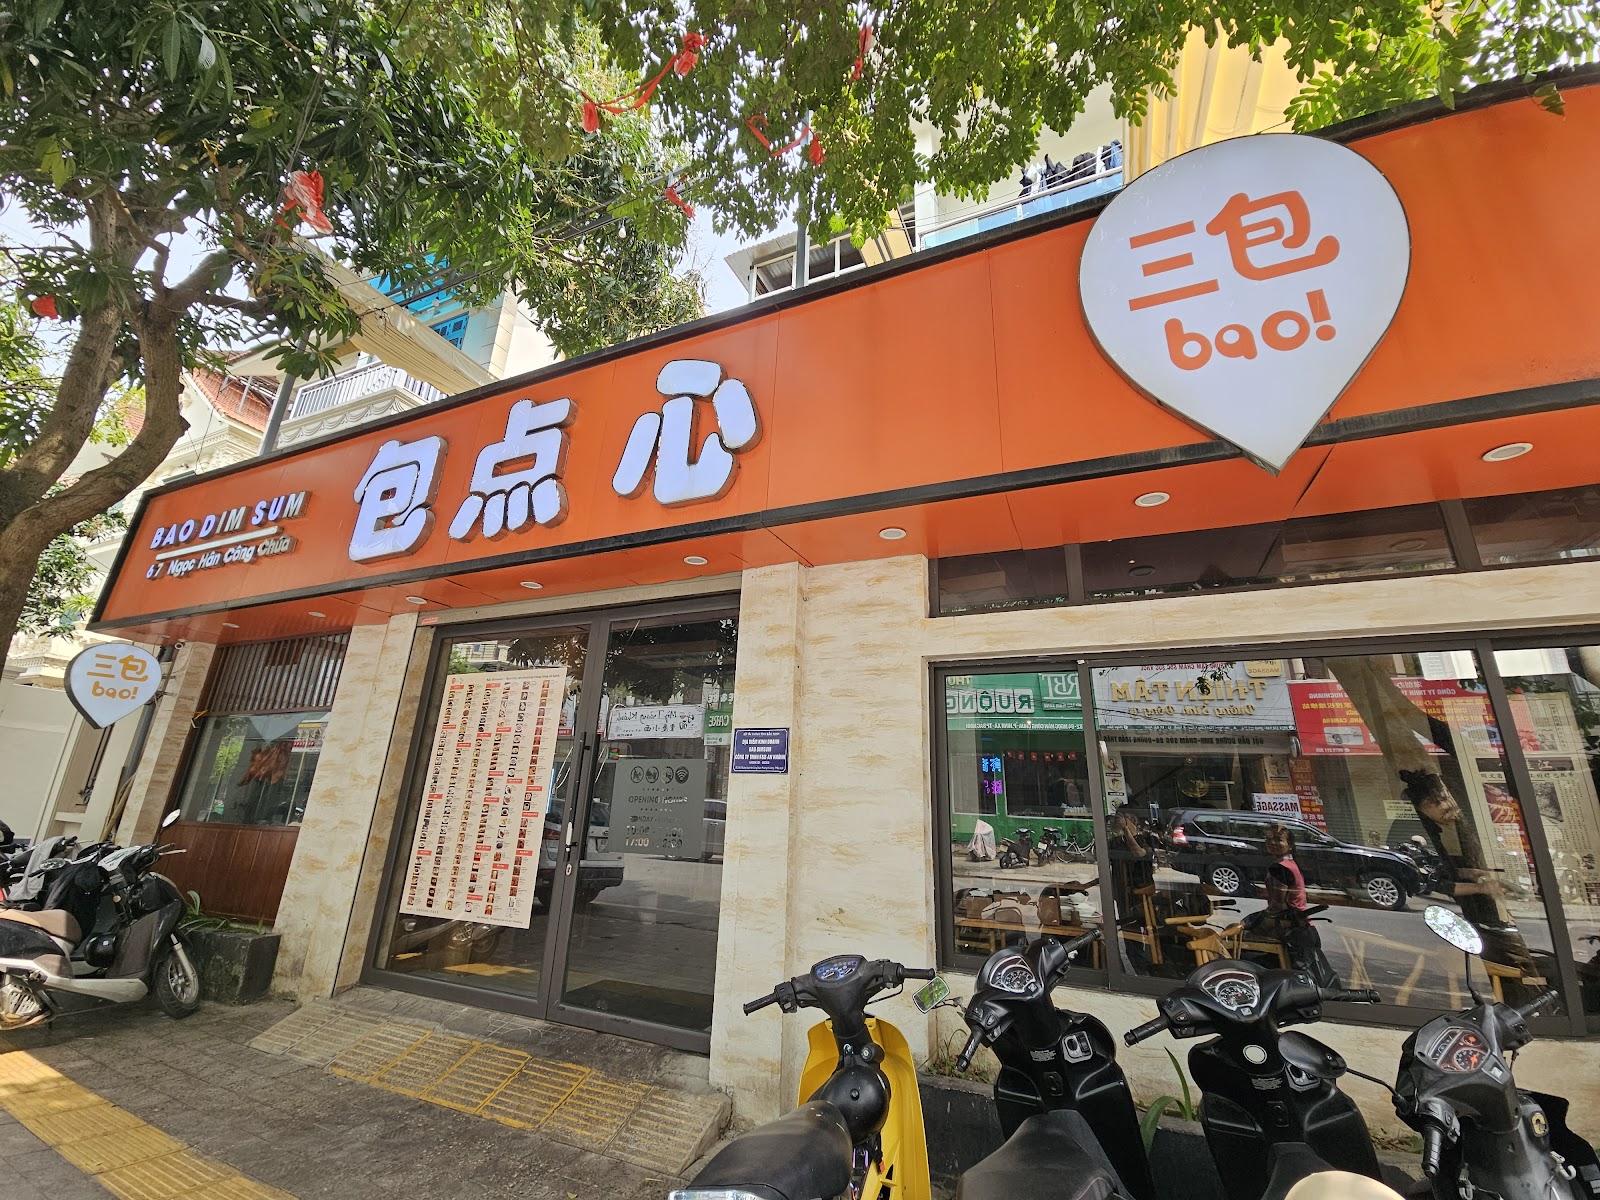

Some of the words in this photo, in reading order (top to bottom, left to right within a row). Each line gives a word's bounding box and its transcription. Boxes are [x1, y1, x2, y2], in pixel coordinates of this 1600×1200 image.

[1128, 190, 1340, 311] 三包
[1164, 288, 1336, 371] bao!
[348, 359, 760, 562] 包点心
[150, 518, 196, 549] BAO
[199, 506, 249, 538] DIM
[251, 491, 309, 526] SUM
[167, 560, 196, 578] Ngọc
[198, 551, 223, 569] Hân
[224, 545, 256, 564] Công
[86, 654, 149, 682] 三包
[92, 681, 139, 700] bao!
[628, 796, 660, 804] OPENING
